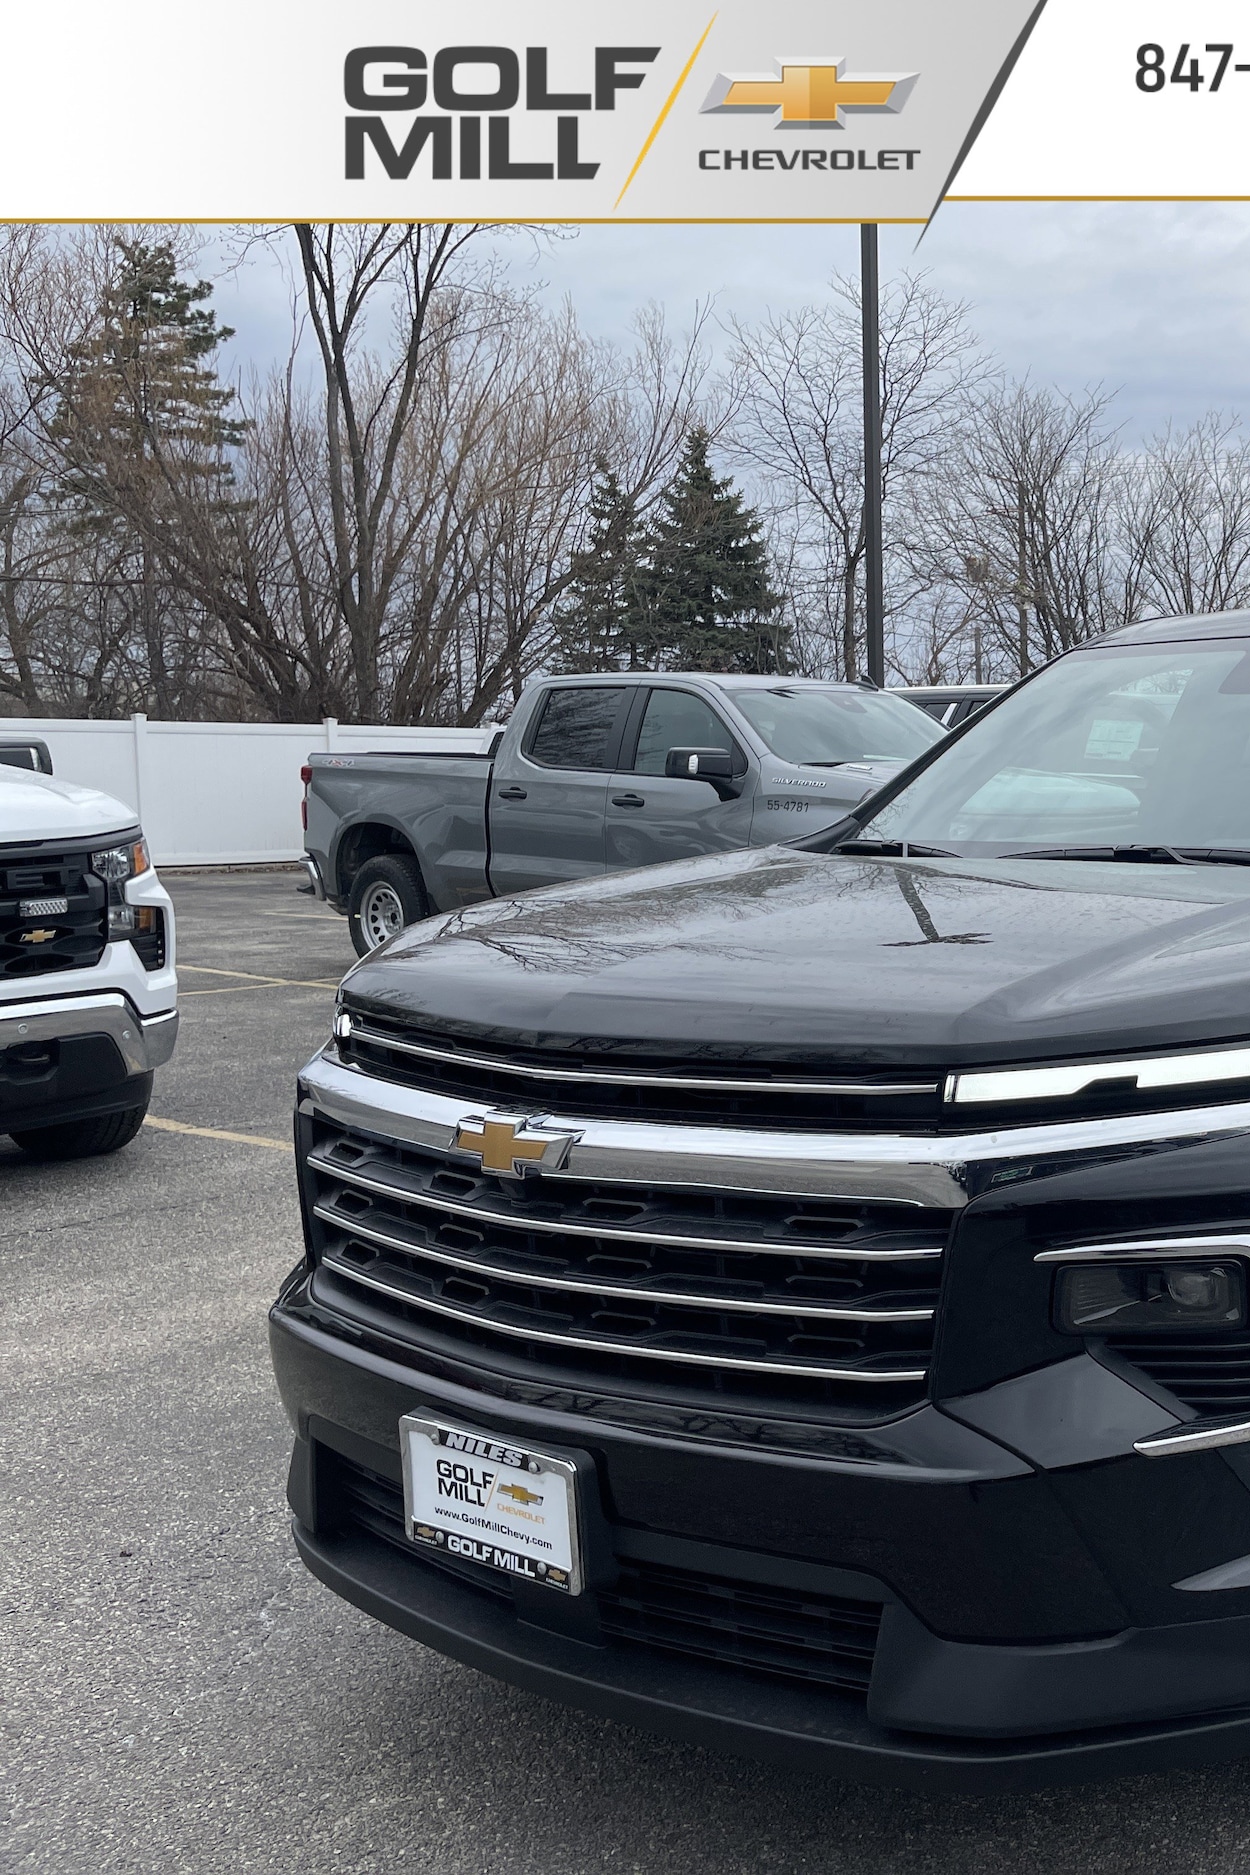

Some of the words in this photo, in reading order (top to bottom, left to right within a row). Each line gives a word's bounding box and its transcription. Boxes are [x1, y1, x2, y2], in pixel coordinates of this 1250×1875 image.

[771, 777, 827, 788] SILVERADO
[767, 800, 809, 813] 55-4781
[446, 1432, 522, 1467] NILES
[436, 1459, 494, 1489] GOLF
[438, 1477, 485, 1507] MILL
[435, 1507, 552, 1550] www.GolfMillChevy.com
[497, 1503, 545, 1525] CHEVROLET
[447, 1534, 493, 1561] GOLF
[494, 1549, 535, 1577] MILL
